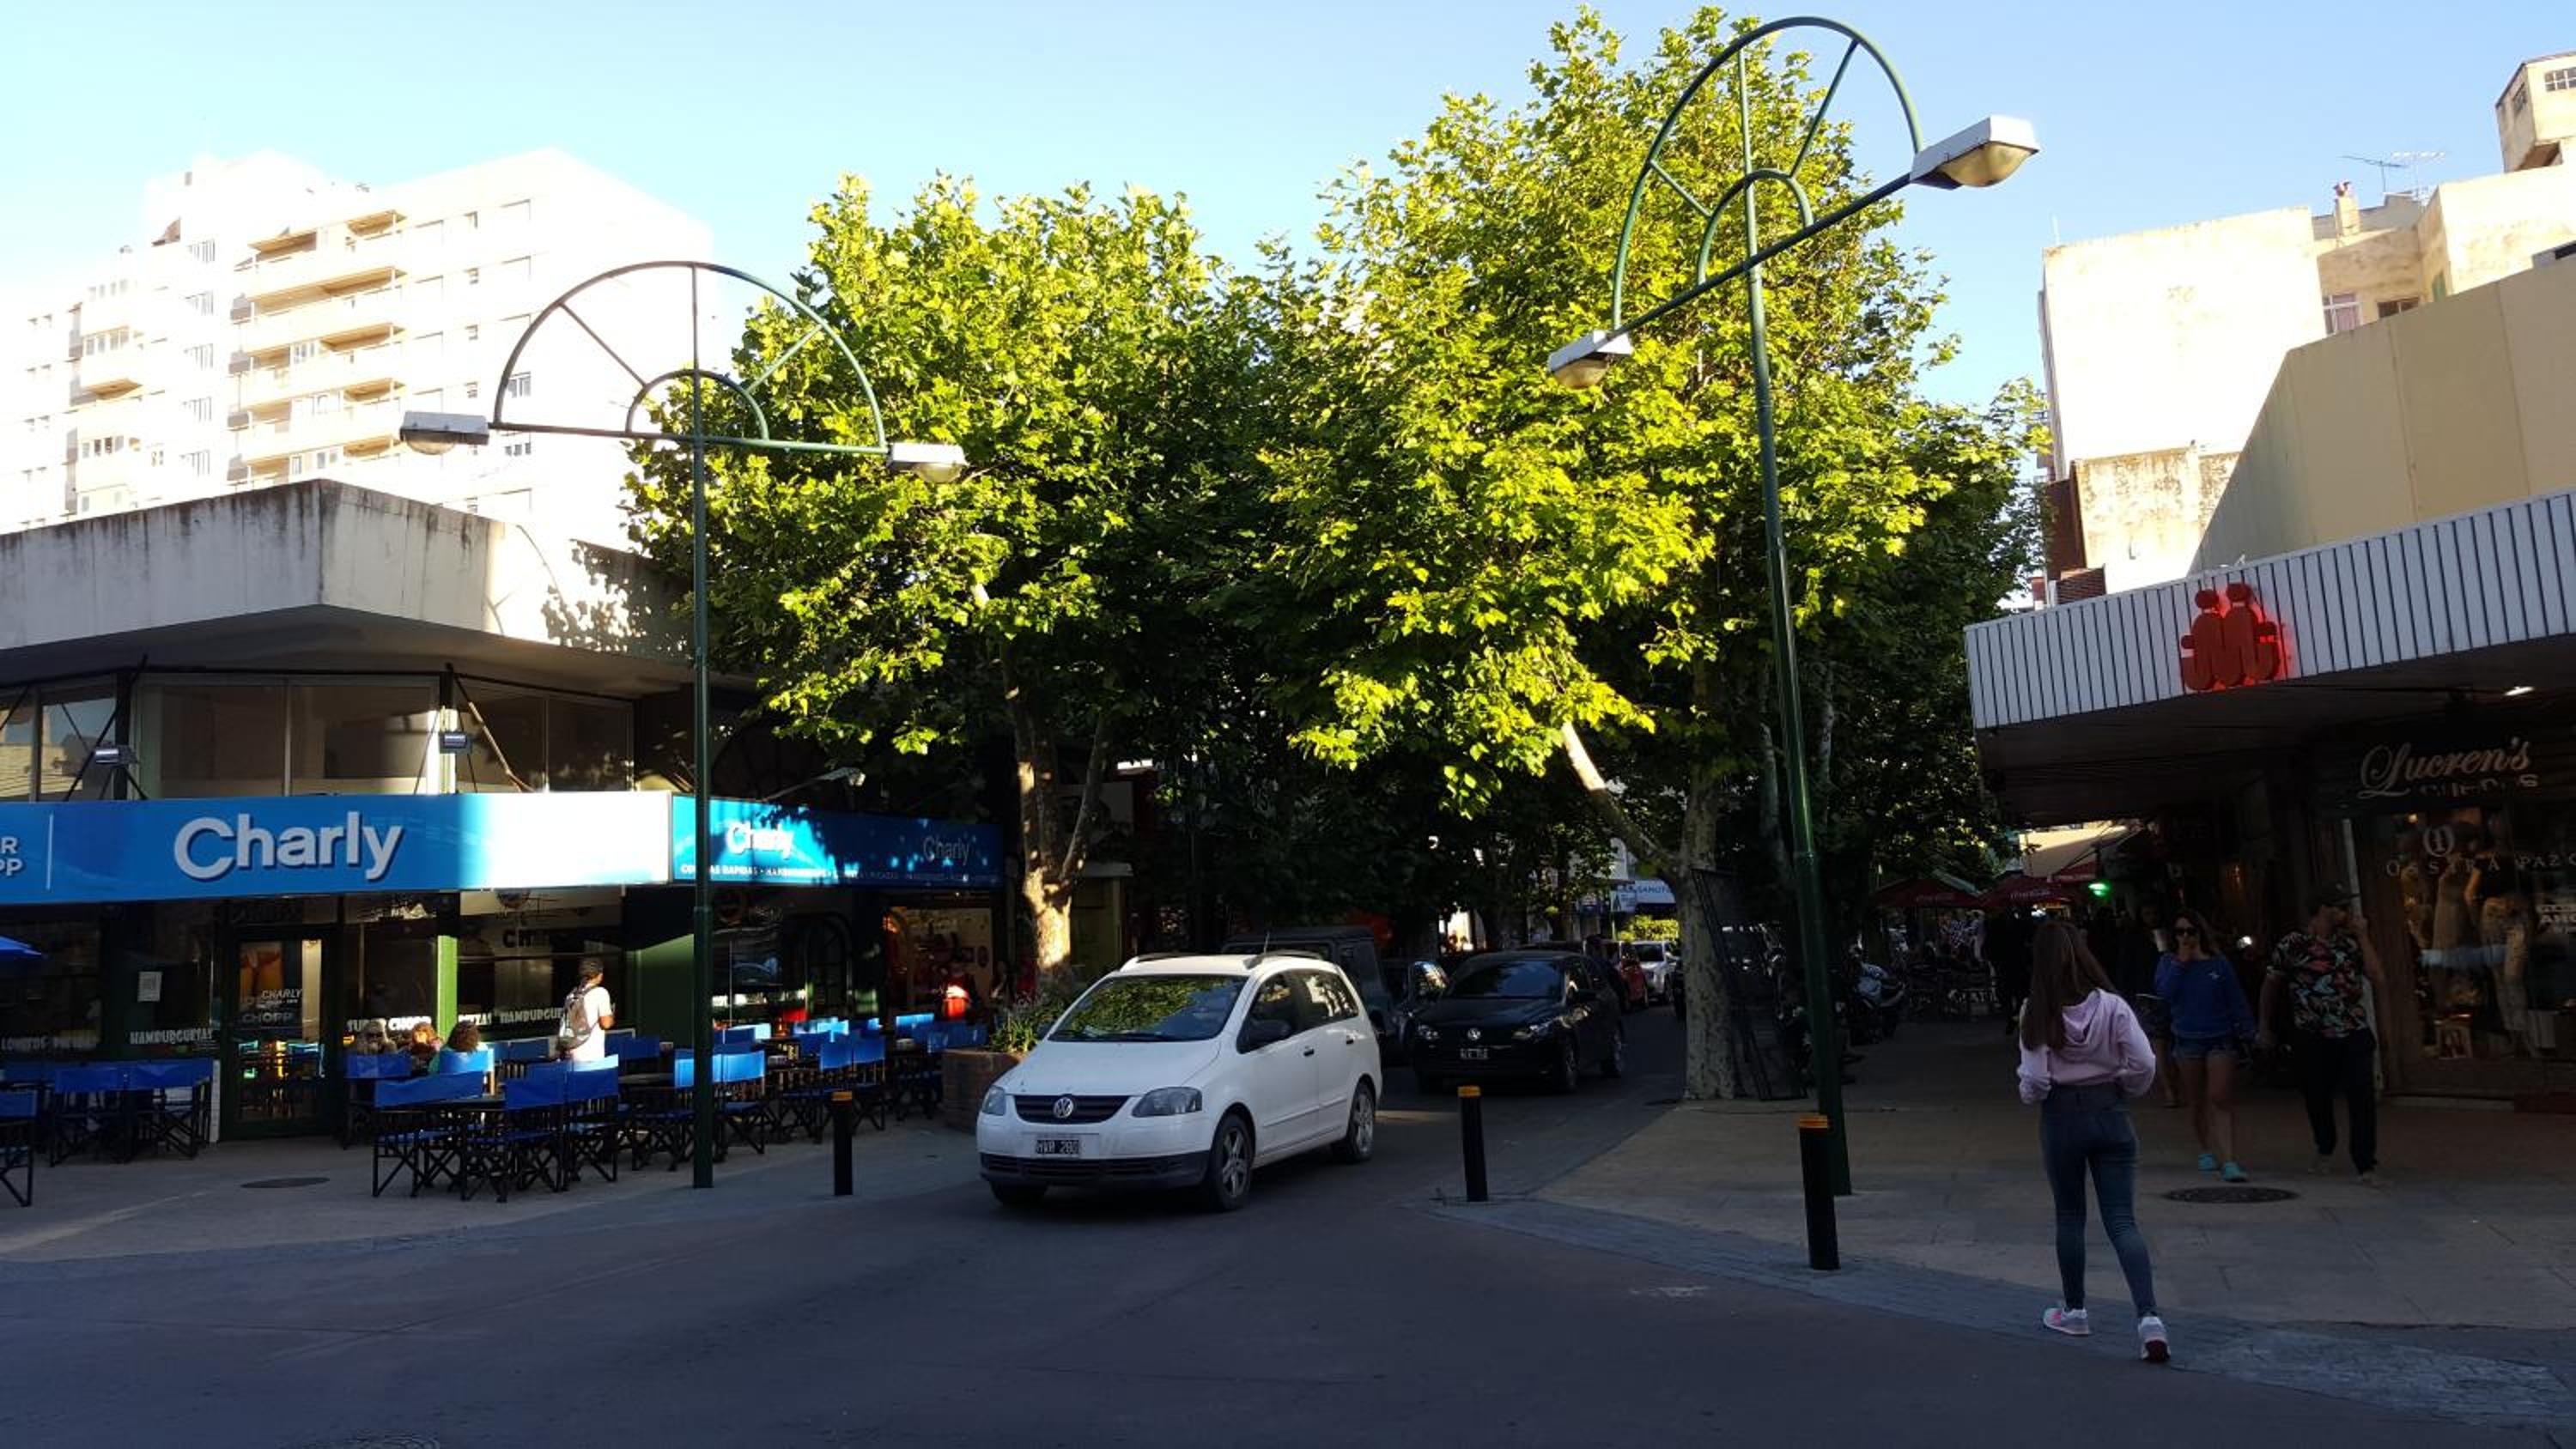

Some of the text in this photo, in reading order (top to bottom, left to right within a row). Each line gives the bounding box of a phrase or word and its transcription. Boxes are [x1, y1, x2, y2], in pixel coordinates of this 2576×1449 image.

[173, 810, 404, 882] Charly
[726, 822, 795, 858] Charly
[923, 836, 971, 866] Charly
